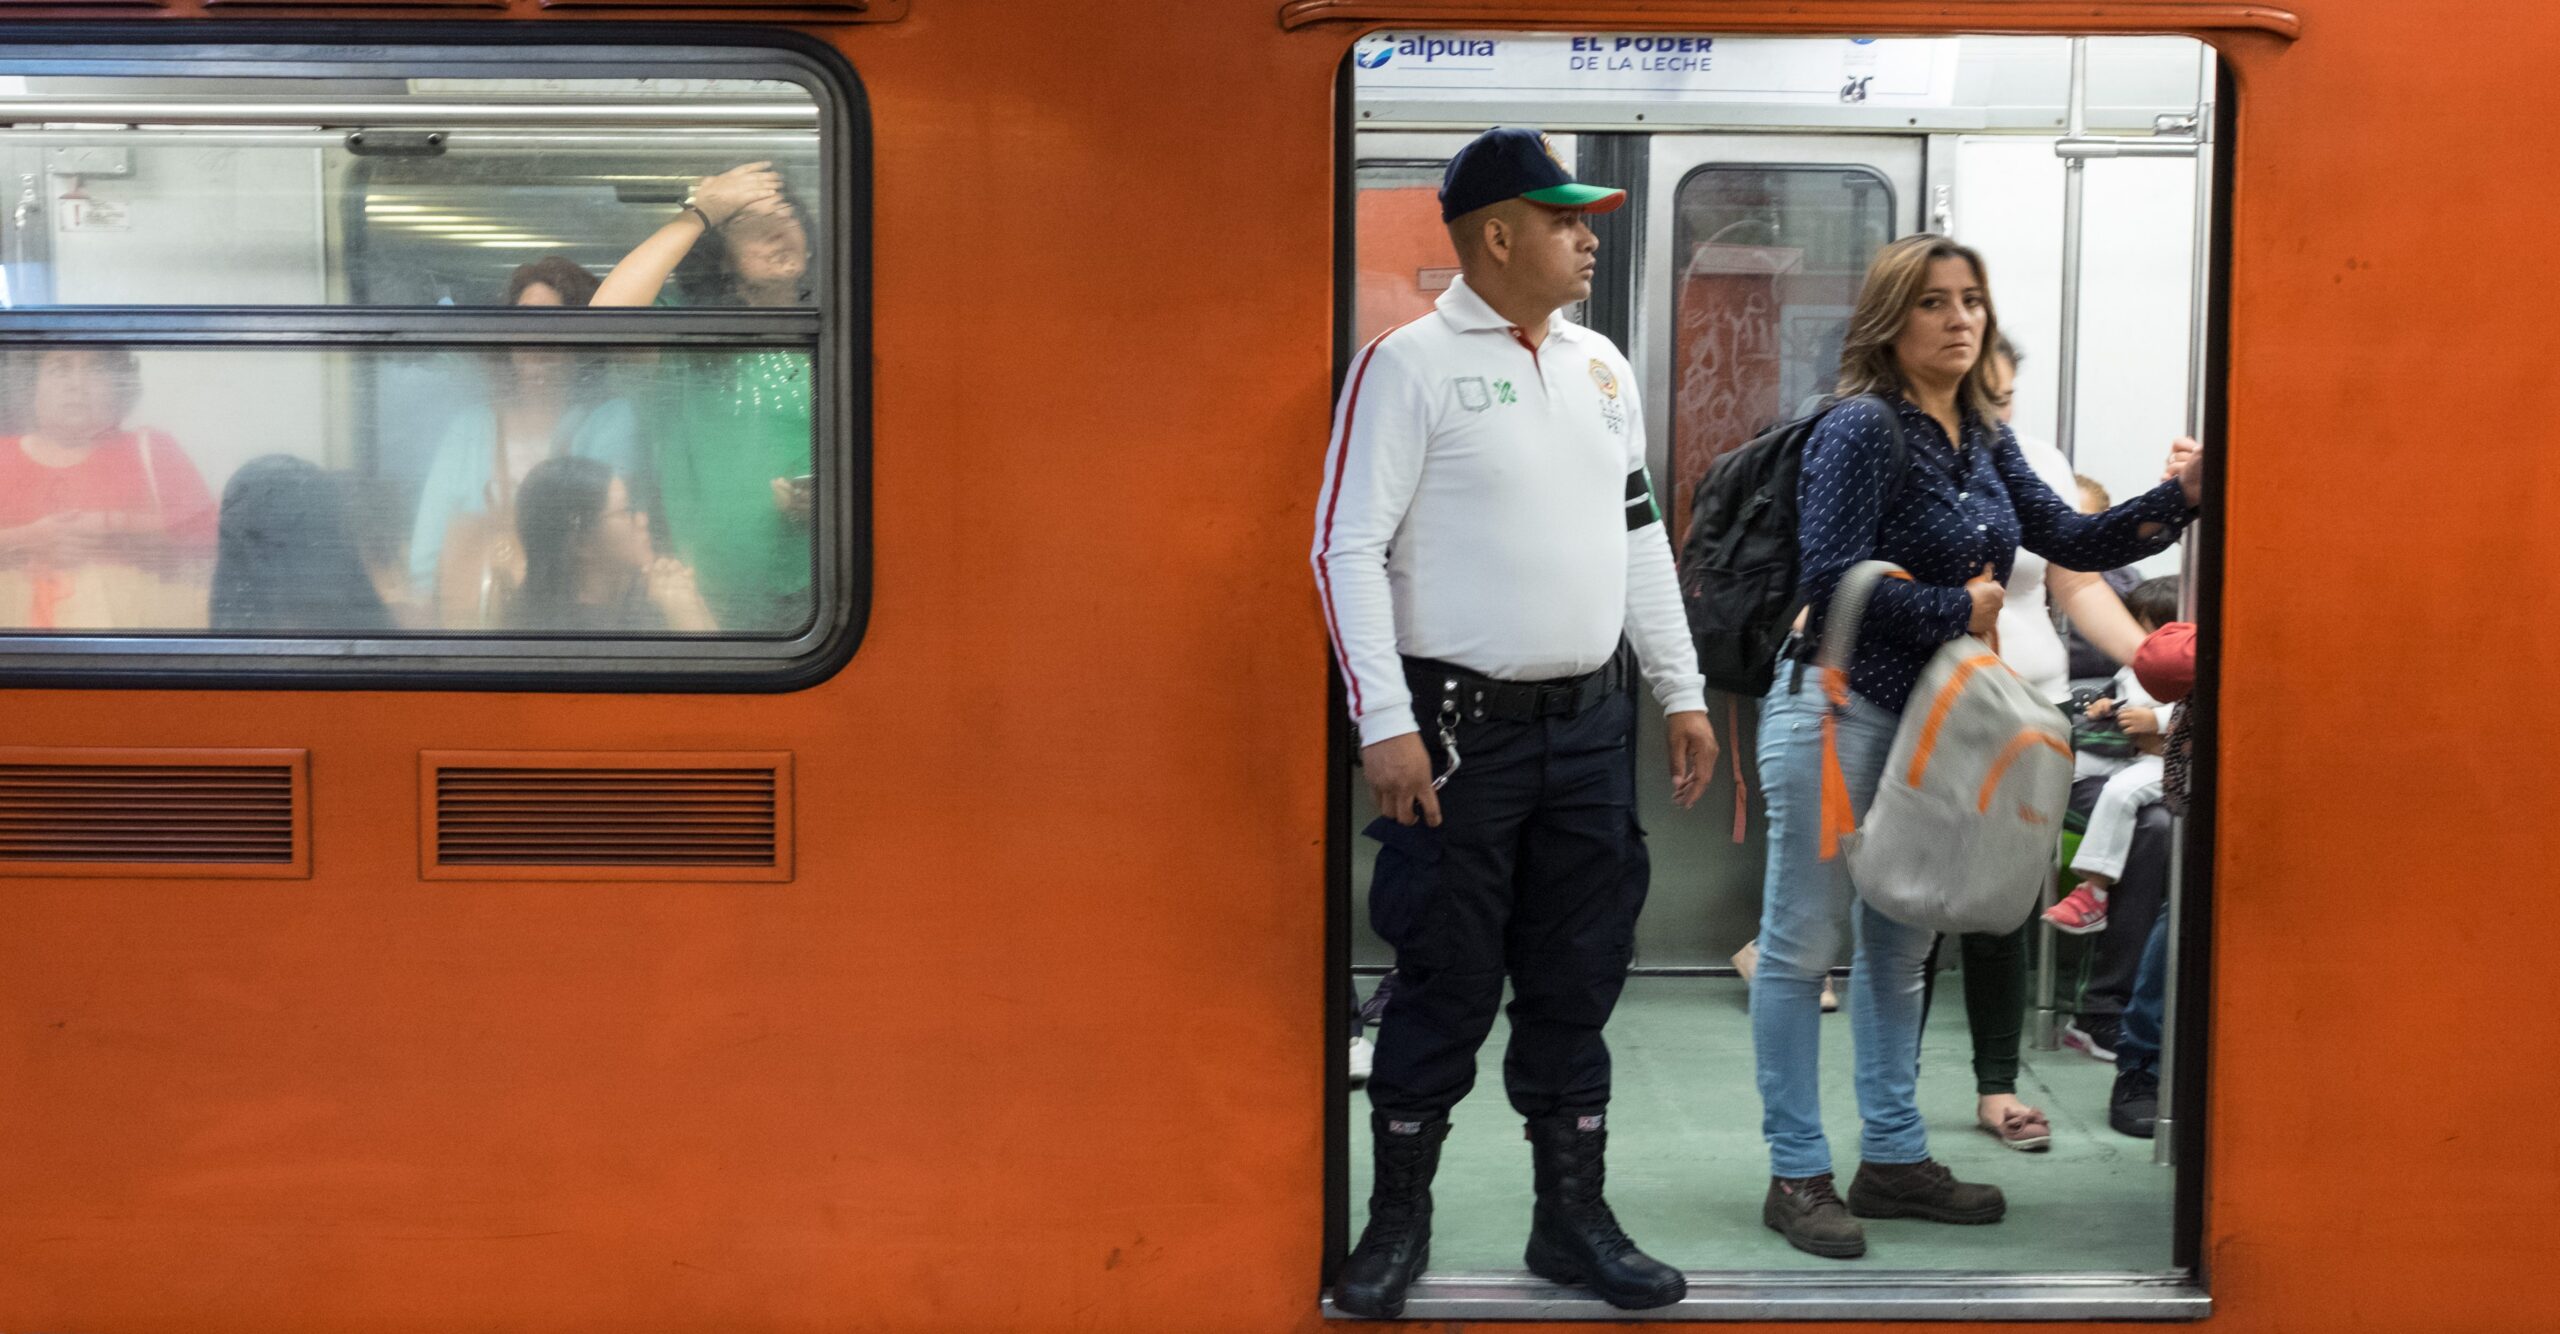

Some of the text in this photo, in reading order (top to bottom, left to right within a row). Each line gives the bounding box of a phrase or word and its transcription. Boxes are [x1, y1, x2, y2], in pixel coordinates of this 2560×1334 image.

[1398, 35, 1495, 62] alpura
[1572, 36, 1713, 53] EL PODER
[1570, 56, 1713, 71] DE LA LECHE
